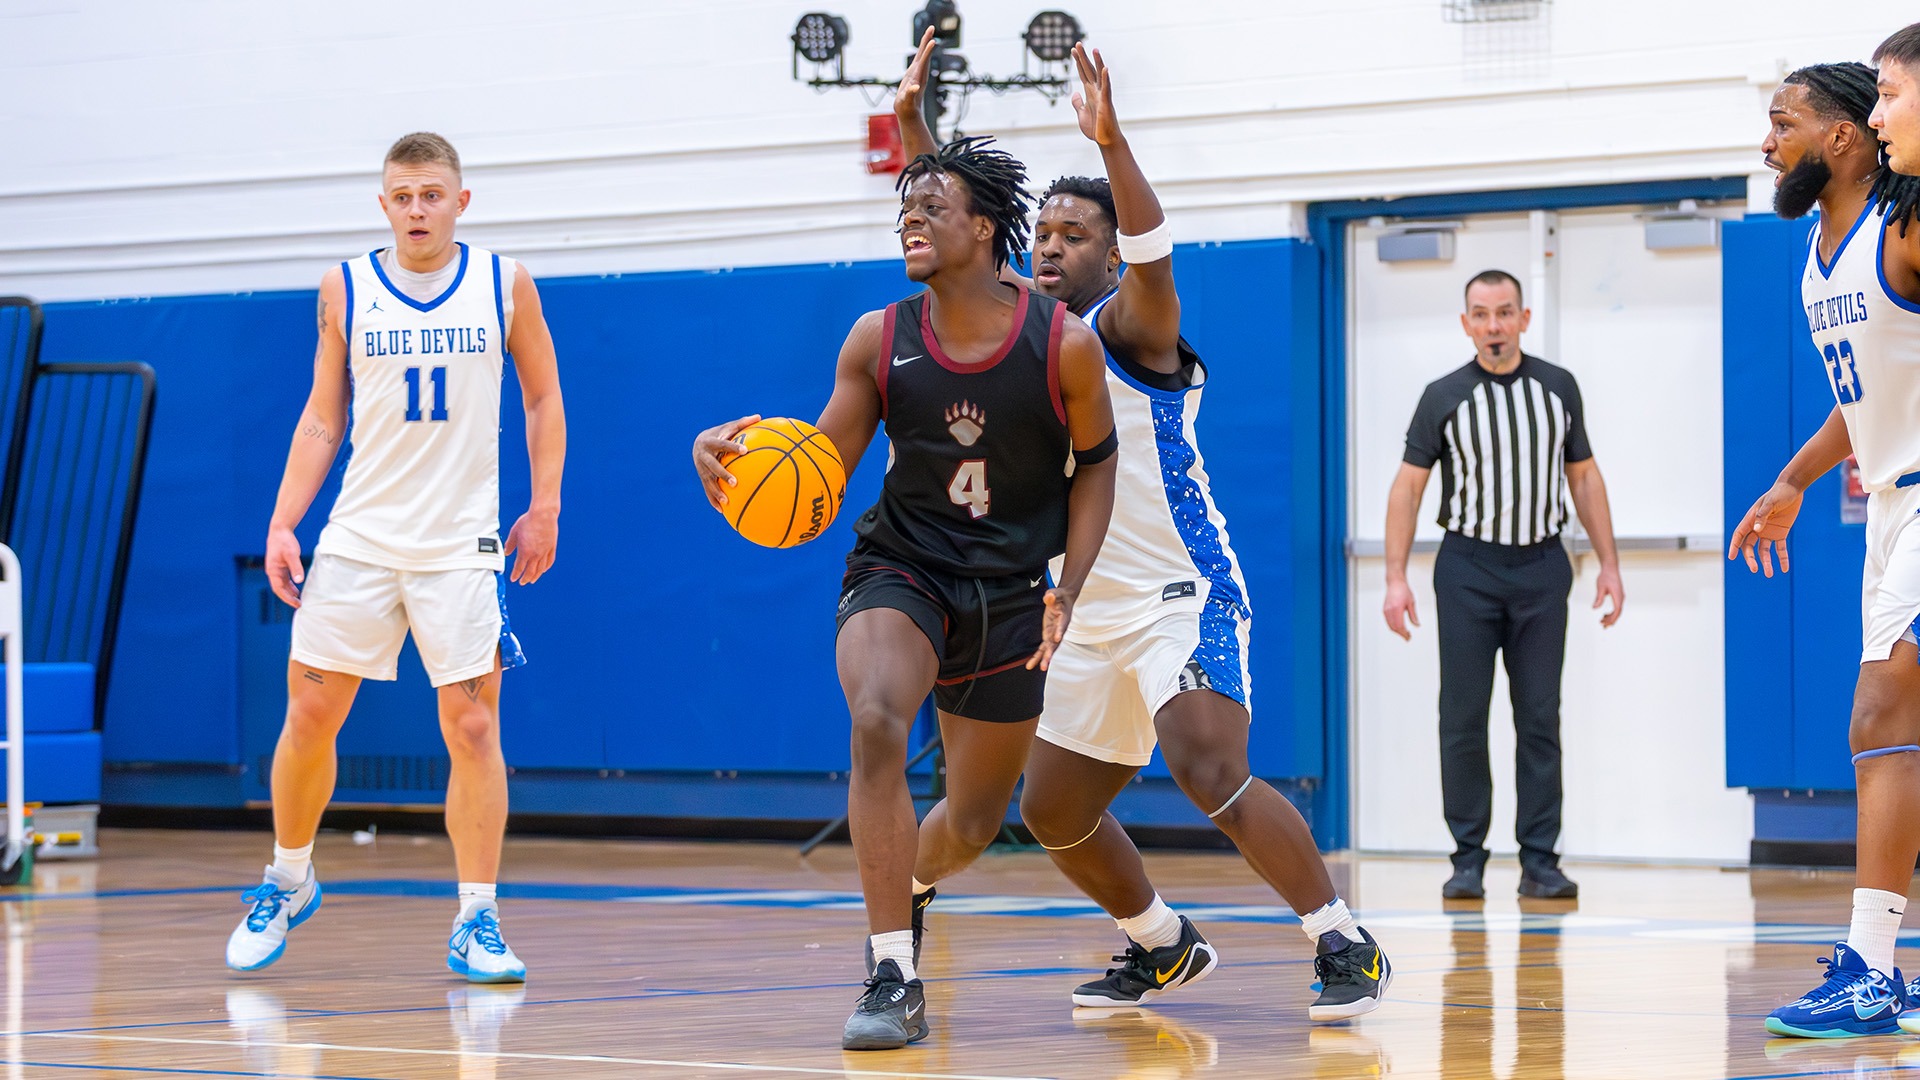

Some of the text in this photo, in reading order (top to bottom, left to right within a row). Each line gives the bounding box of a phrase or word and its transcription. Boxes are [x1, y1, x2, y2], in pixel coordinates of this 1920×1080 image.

[1826, 291, 1868, 328] DEVILS
[365, 327, 487, 357] BLUE DEVILS
[403, 365, 449, 422] 11
[1823, 338, 1865, 406] 23
[946, 458, 992, 520] 4
